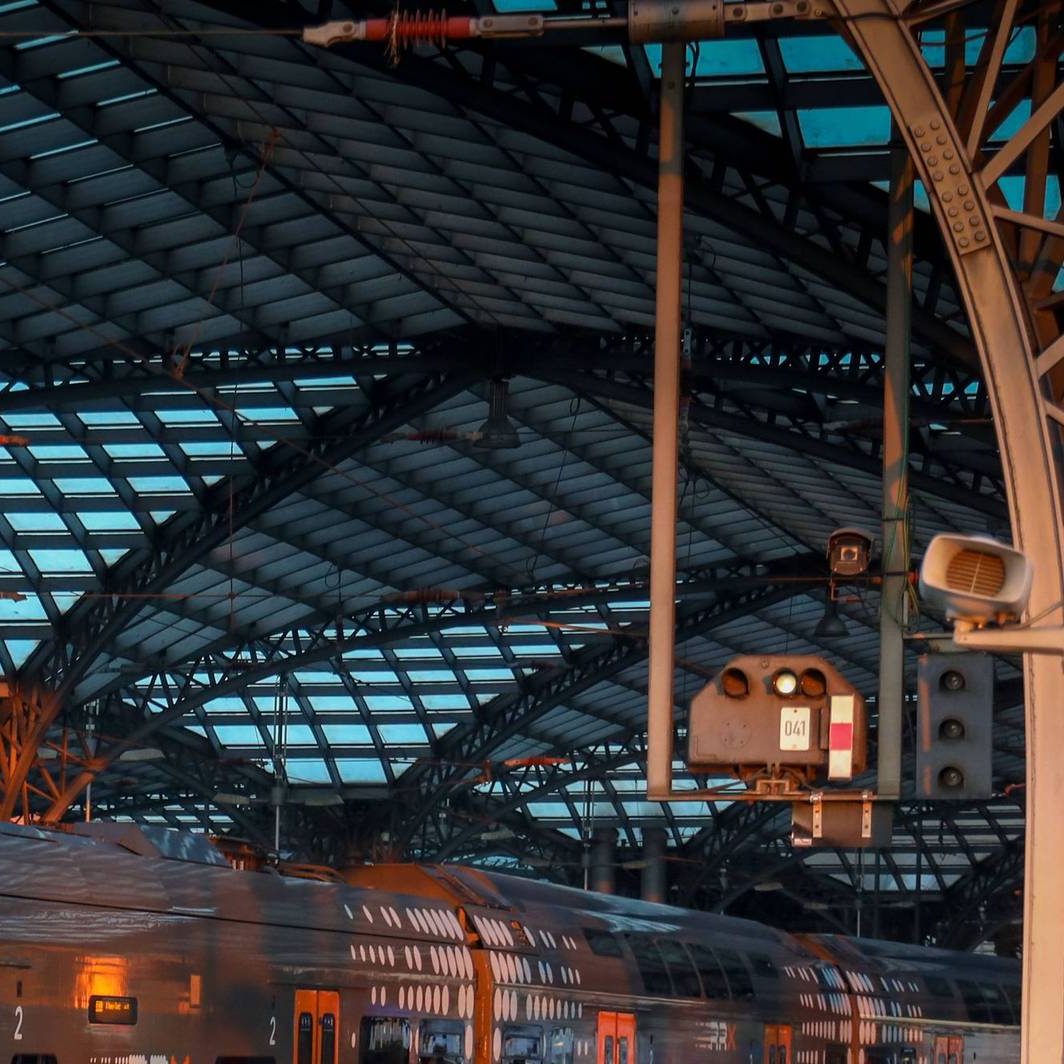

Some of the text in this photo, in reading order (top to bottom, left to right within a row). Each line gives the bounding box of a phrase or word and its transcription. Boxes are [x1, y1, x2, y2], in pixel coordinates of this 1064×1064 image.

[785, 720, 806, 737] 041
[14, 1005, 23, 1040] 2
[269, 1016, 276, 1046] 2
